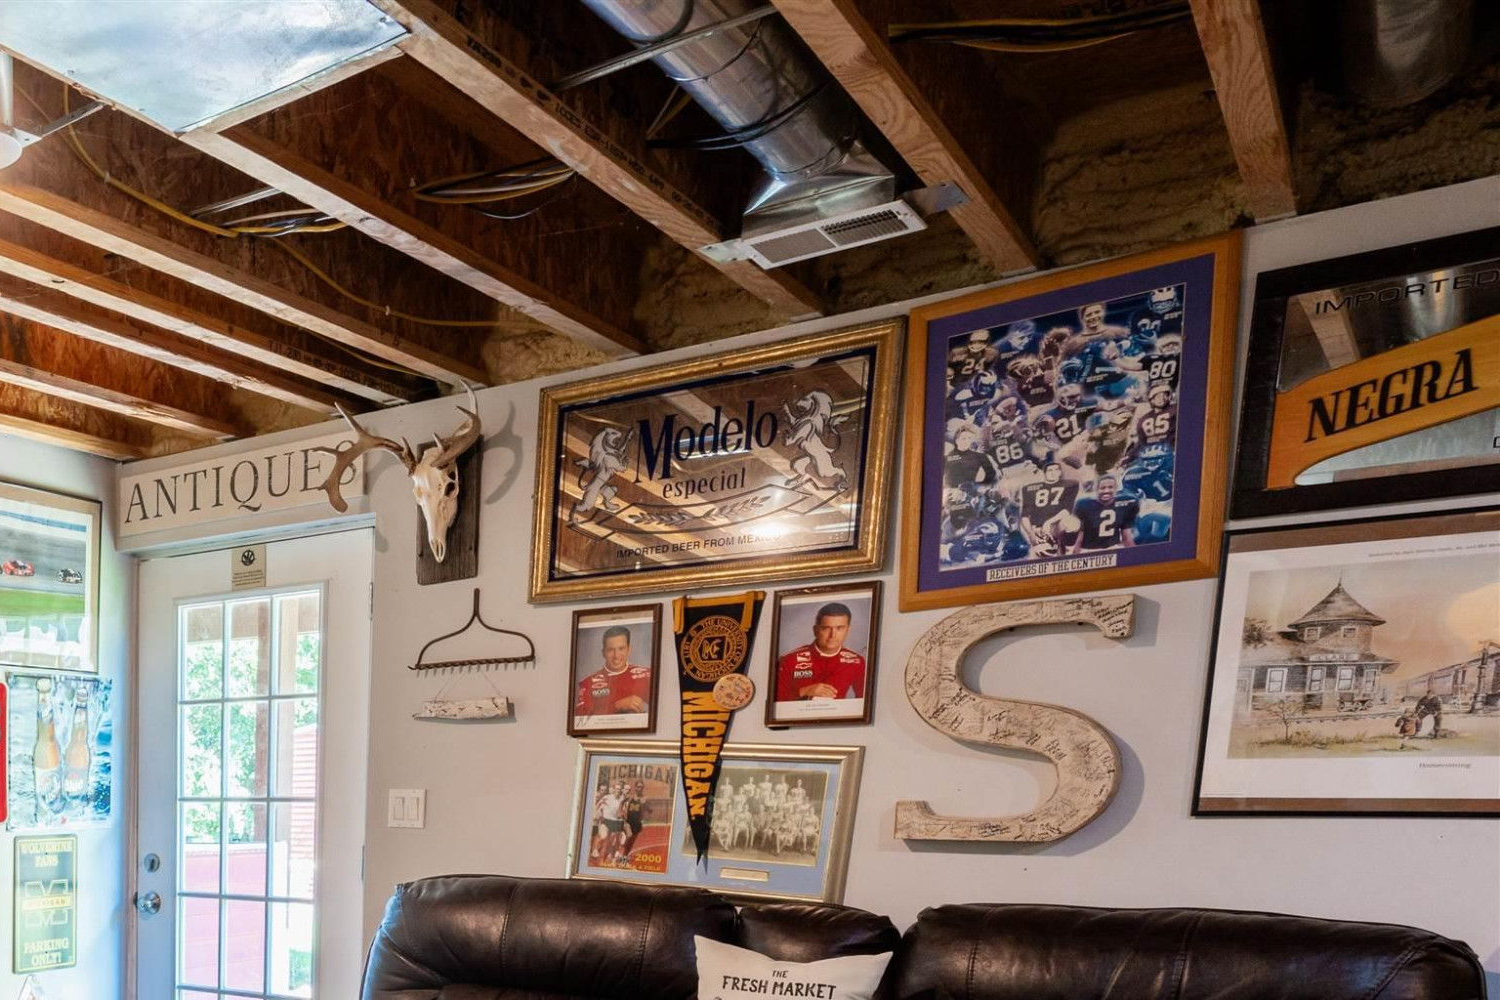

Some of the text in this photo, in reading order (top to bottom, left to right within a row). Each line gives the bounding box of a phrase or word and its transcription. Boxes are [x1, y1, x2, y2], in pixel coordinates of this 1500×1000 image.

[1315, 269, 1500, 314] IMPORTED
[962, 358, 985, 375] 24
[1150, 360, 1176, 379] 80
[1303, 347, 1480, 443] NEGRA
[1056, 416, 1083, 440] 21
[1141, 415, 1170, 439] 85
[634, 401, 778, 484] Modelo
[995, 445, 1024, 464] 86
[663, 467, 745, 499] especial
[1153, 481, 1170, 497] 1
[1035, 487, 1065, 508] 87
[1098, 509, 1117, 537] 2
[616, 544, 669, 559] IMPORTED
[671, 540, 701, 552] BEER
[704, 537, 735, 550] FROM
[989, 554, 1115, 580] RECEIVERS OF THE CENTURY
[794, 670, 813, 678] BOSS
[682, 691, 732, 816] MICHIGAN
[600, 765, 677, 784] MICHIGAN
[20, 841, 73, 854] WOLVERINE
[35, 855, 59, 868] FANS
[635, 853, 662, 863] 2000
[24, 938, 70, 954] PARKING
[31, 951, 62, 966] ONLY!
[772, 970, 788, 978] THE
[722, 975, 837, 1000] FRESH MARKET
